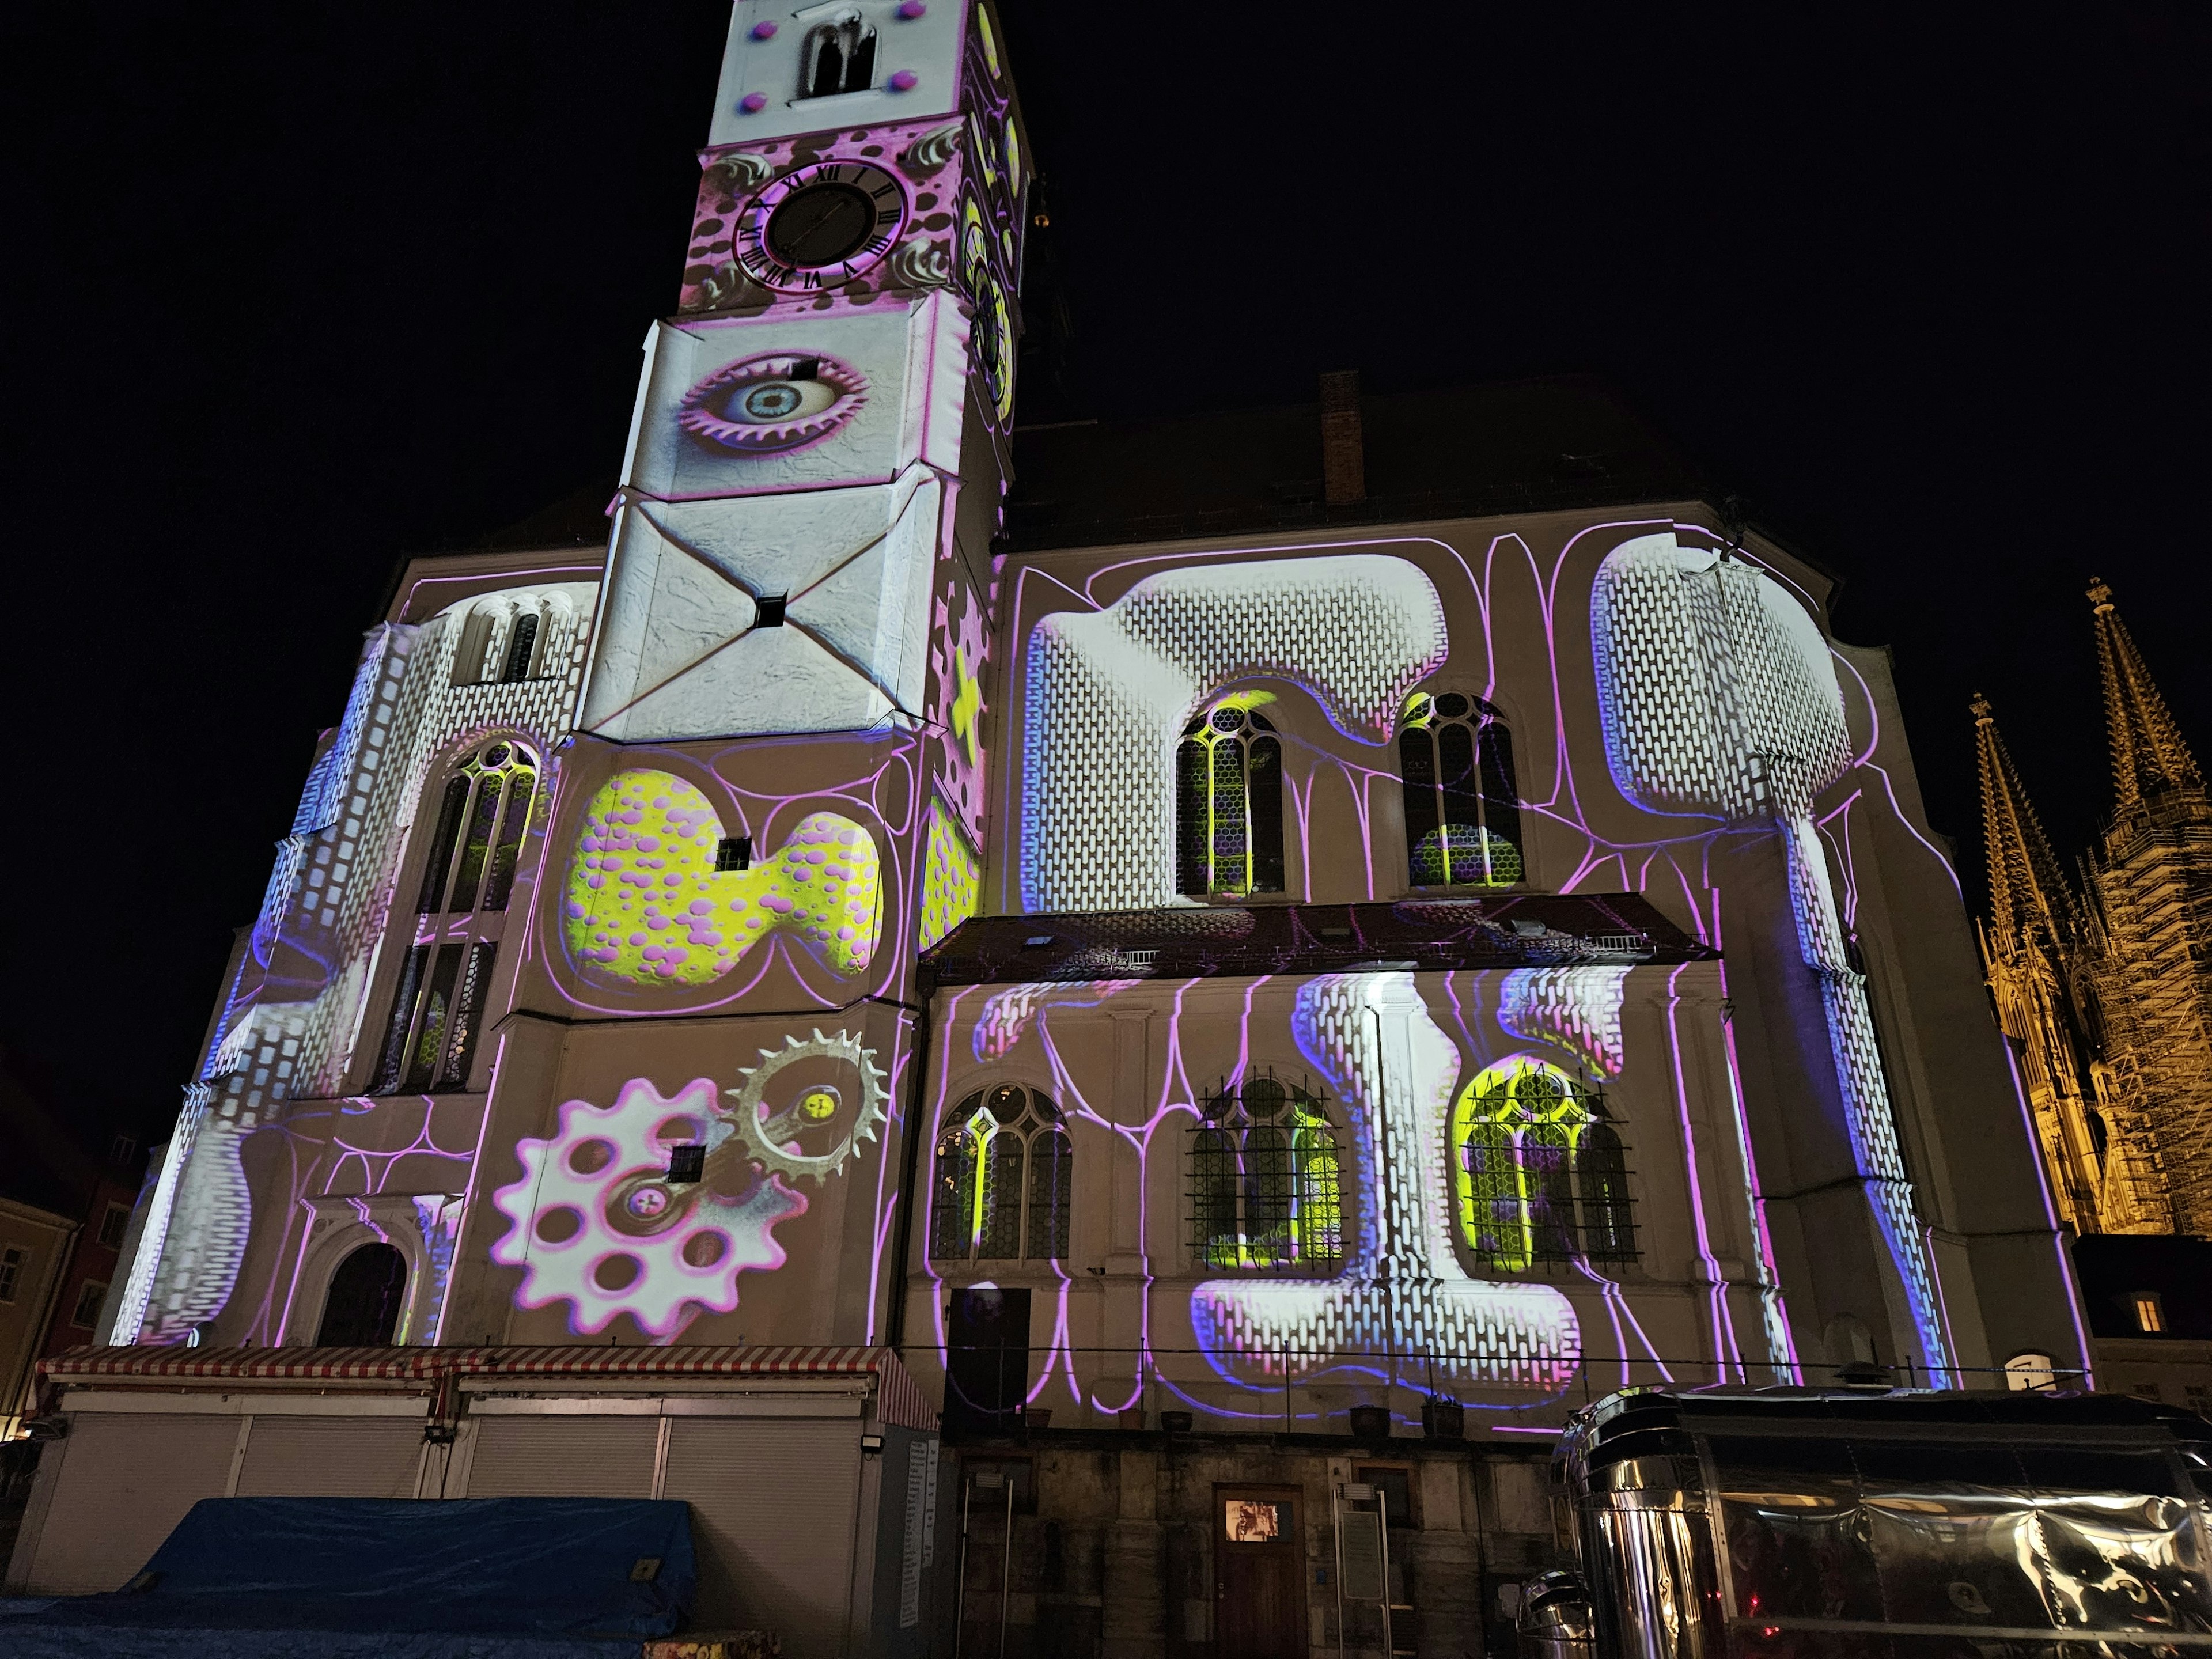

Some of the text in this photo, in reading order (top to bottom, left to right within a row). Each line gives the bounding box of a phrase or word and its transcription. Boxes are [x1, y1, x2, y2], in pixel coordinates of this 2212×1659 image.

[813, 164, 842, 183] XII
[780, 173, 804, 194] XI
[878, 209, 902, 225] III
